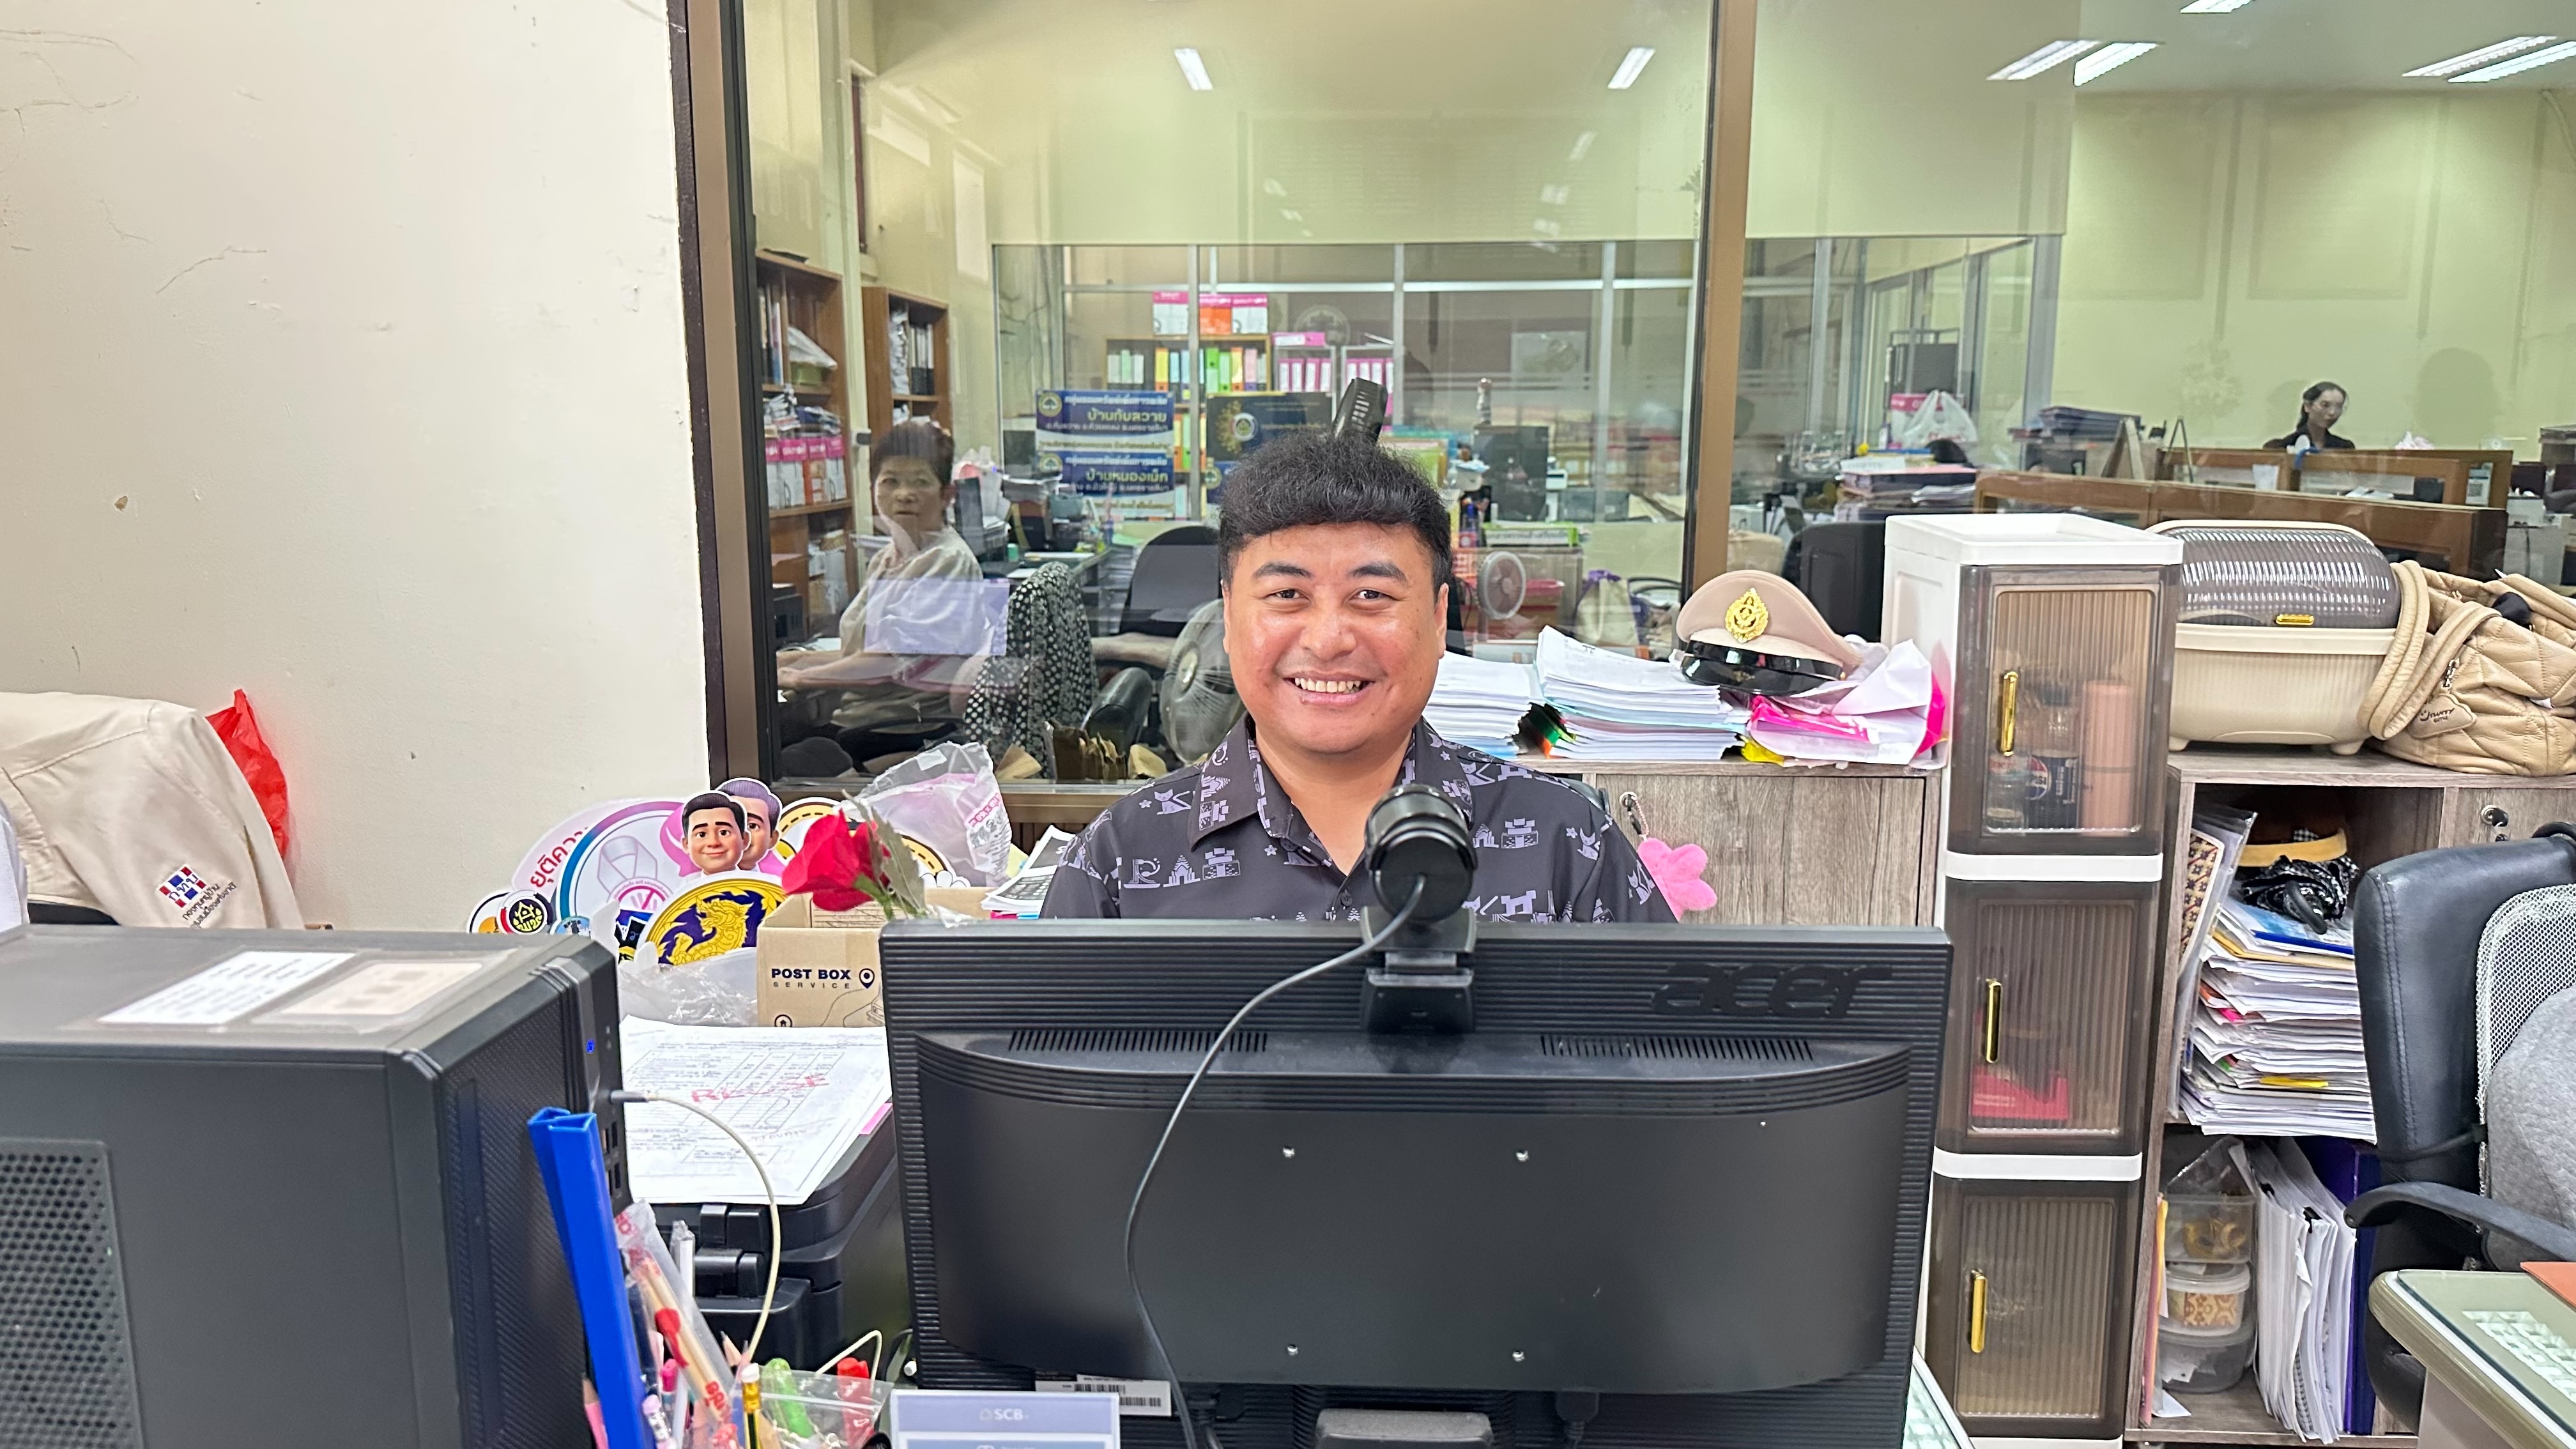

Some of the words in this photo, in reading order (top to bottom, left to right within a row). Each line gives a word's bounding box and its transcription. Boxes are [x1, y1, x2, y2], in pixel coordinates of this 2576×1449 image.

[168, 873, 199, 901] กทบ
[772, 969, 812, 979] POST
[818, 969, 852, 980] BOX
[1651, 962, 1892, 1018] acer
[994, 1408, 1023, 1420] SCB
